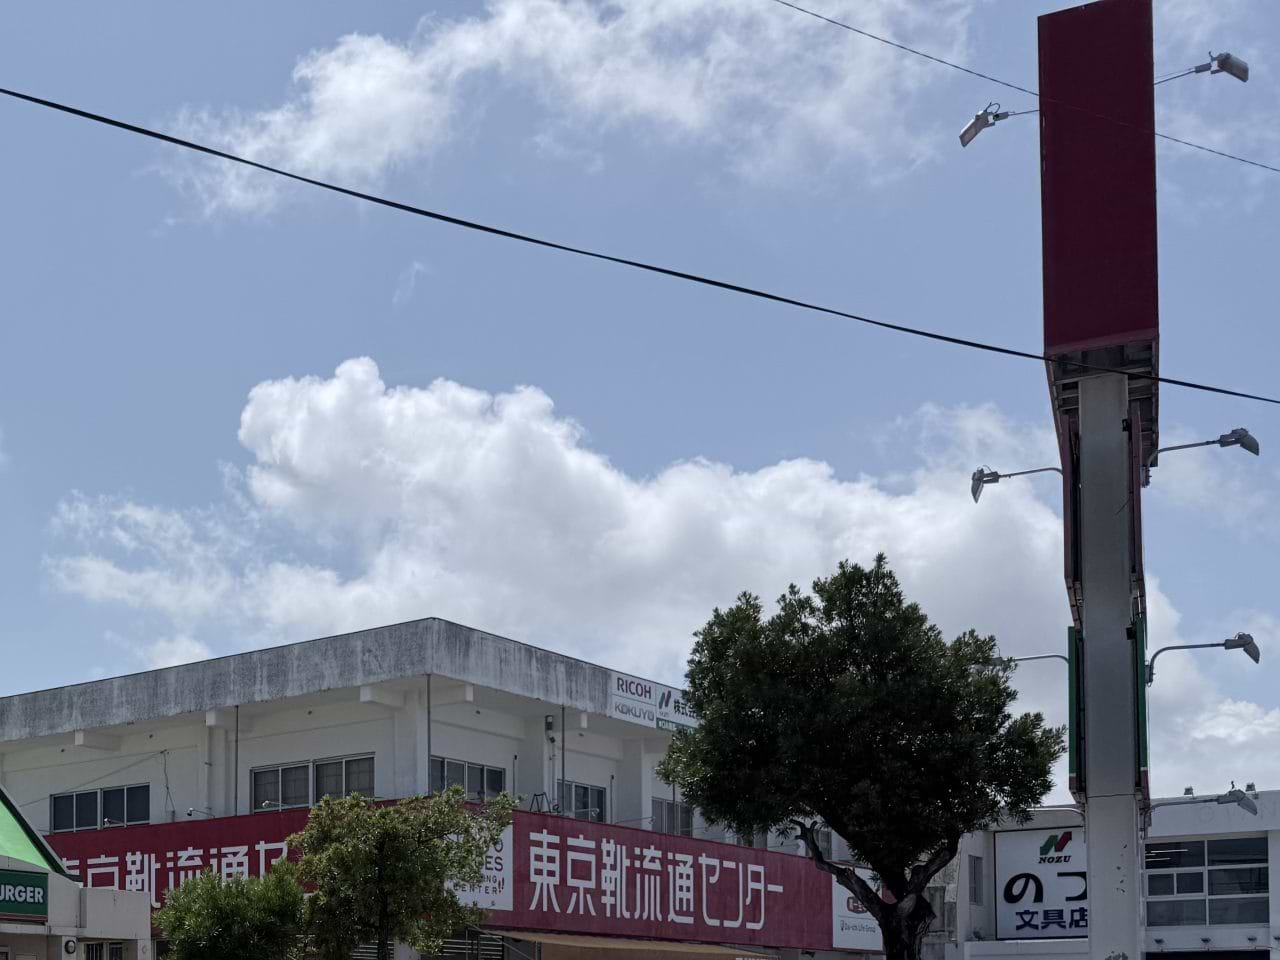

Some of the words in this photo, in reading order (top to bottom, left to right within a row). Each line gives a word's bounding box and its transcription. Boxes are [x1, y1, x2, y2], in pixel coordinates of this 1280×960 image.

[616, 677, 652, 699] RICOH
[1038, 855, 1071, 864] NOZU
[529, 829, 784, 930] 東京靴流通センター
[1015, 907, 1088, 931] 文具店
